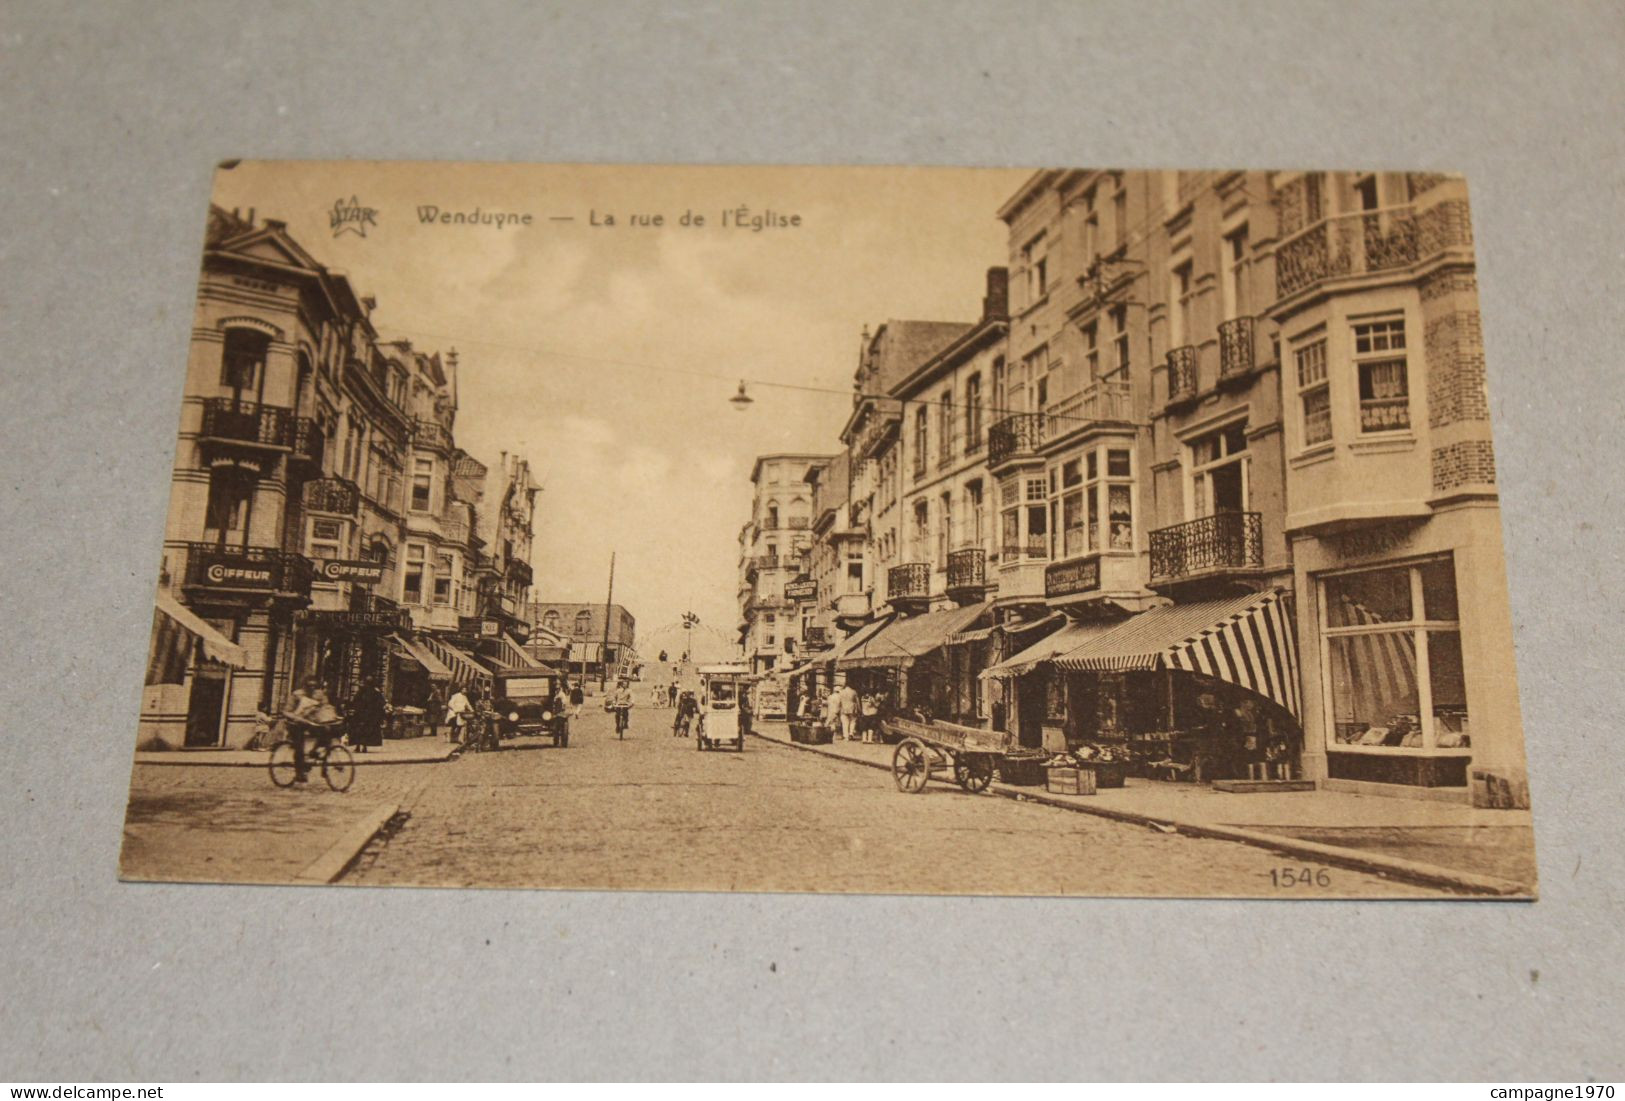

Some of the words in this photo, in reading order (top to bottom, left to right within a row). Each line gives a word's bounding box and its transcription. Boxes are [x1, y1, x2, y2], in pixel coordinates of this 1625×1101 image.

[327, 198, 379, 229] STAR
[416, 204, 534, 229] Wenduyne
[589, 209, 616, 227] La
[629, 212, 665, 228] rue
[679, 208, 706, 228] de
[722, 204, 803, 232] l'Église
[1270, 867, 1331, 888] 1546
